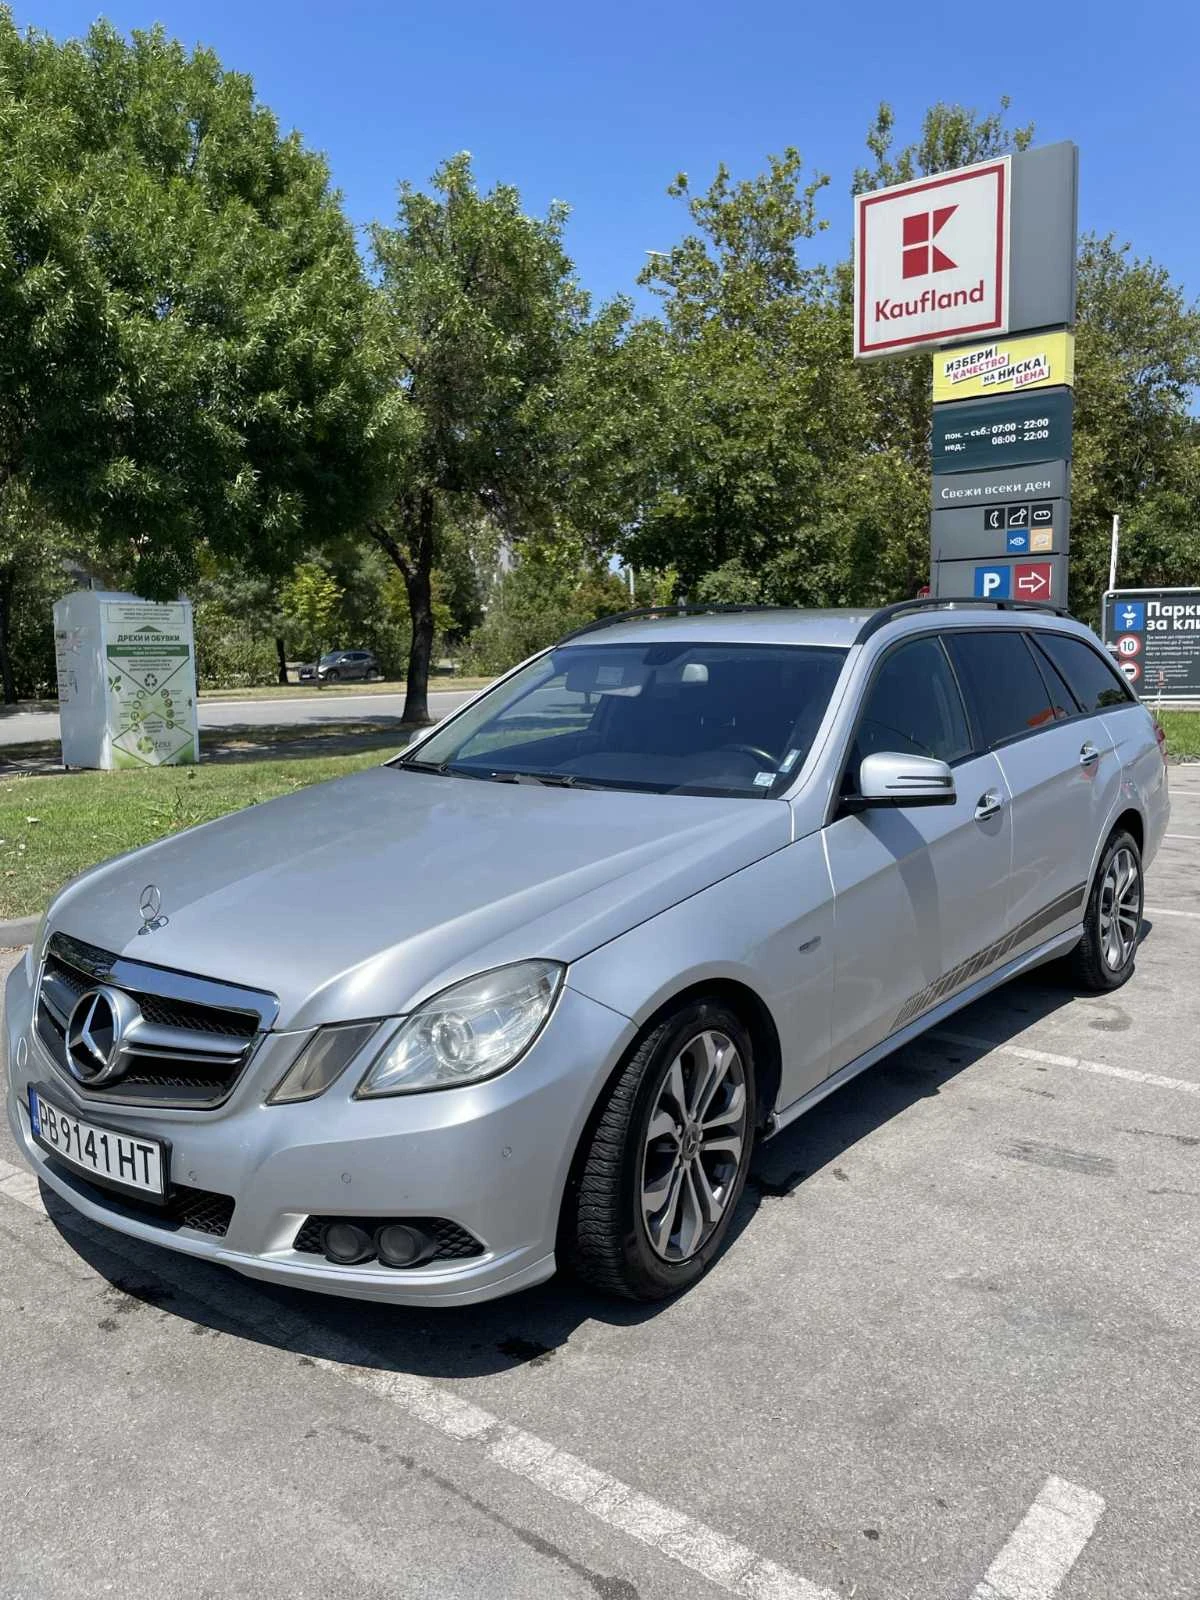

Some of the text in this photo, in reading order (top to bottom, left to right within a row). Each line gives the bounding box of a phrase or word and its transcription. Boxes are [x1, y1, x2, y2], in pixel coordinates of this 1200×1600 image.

[875, 279, 985, 323] Kaufland
[946, 348, 993, 373] ИЗБЕРИ
[952, 356, 1006, 381] КАЧЕСТВО
[983, 358, 1042, 383] НА НИСКА
[1015, 368, 1045, 385] ЦЕНА
[991, 423, 1016, 434] 07:00
[1023, 418, 1049, 430] 22:00
[991, 434, 1016, 445] 08:00
[1023, 430, 1049, 441] 22:00
[941, 480, 1051, 500] Свежи всеки ден
[983, 573, 1001, 598] P
[1146, 619, 1168, 631] за
[117, 634, 143, 642] ДРЕХИ
[151, 634, 180, 642] ОБУВКИ
[1122, 640, 1135, 652] 10
